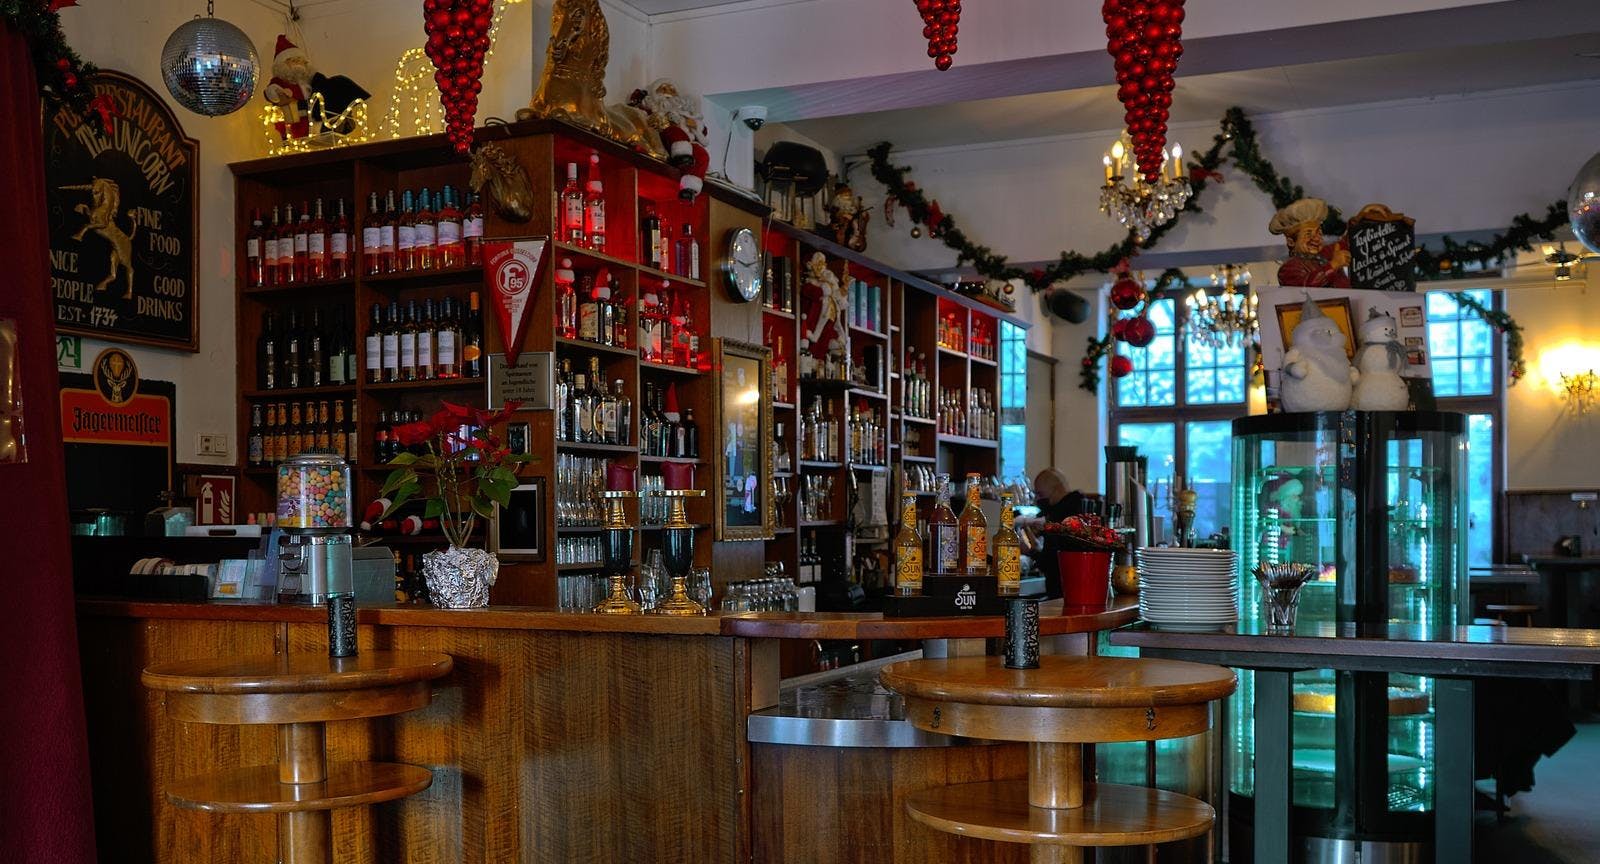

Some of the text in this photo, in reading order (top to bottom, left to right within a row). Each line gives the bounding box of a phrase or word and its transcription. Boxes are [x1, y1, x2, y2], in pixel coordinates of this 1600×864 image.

[113, 117, 175, 195] UNICORN
[137, 206, 162, 230] FINE
[149, 232, 181, 256] FOOD
[49, 249, 79, 273] NICE
[51, 277, 94, 304] PEOPLE
[153, 275, 186, 298] GOOD
[510, 277, 524, 289] 95
[90, 306, 119, 328] 1734
[137, 296, 183, 321] DRINKS
[954, 590, 976, 606] SUN
